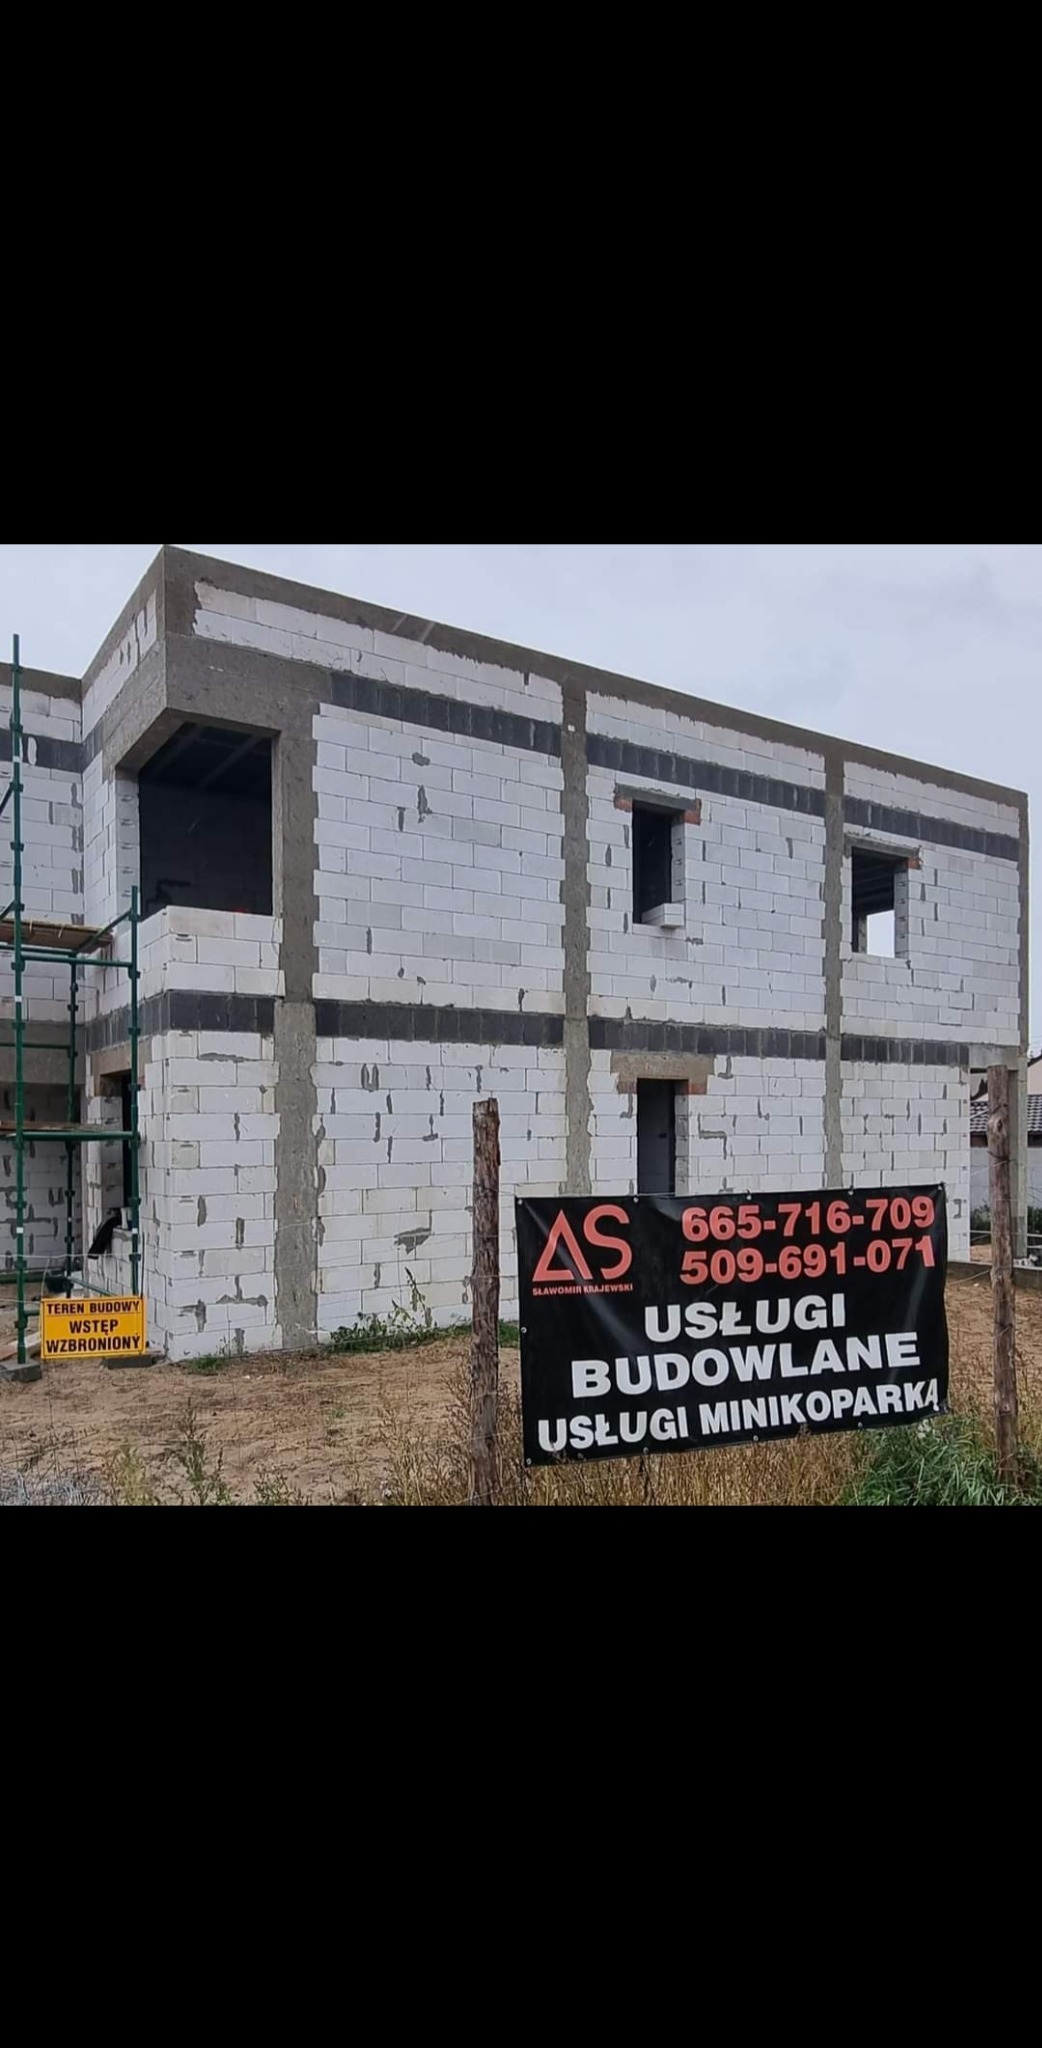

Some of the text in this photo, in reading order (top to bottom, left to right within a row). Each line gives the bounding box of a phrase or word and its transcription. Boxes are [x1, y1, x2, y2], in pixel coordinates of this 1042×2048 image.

[532, 1204, 633, 1282] AS
[681, 1195, 936, 1243] 665-716-709
[680, 1235, 936, 1285] 509-691-071
[46, 1301, 140, 1315] TEREN BUDOWY
[532, 1283, 633, 1296] SŁAWOMIR KRAJEWSKI
[69, 1319, 119, 1335] WSTĘP
[644, 1293, 846, 1343] USŁUGI
[46, 1336, 141, 1353] WZBRONIONY
[571, 1331, 921, 1399] BUDOWLANE
[537, 1378, 940, 1453] USŁUGI MINIKOPARKĄ
